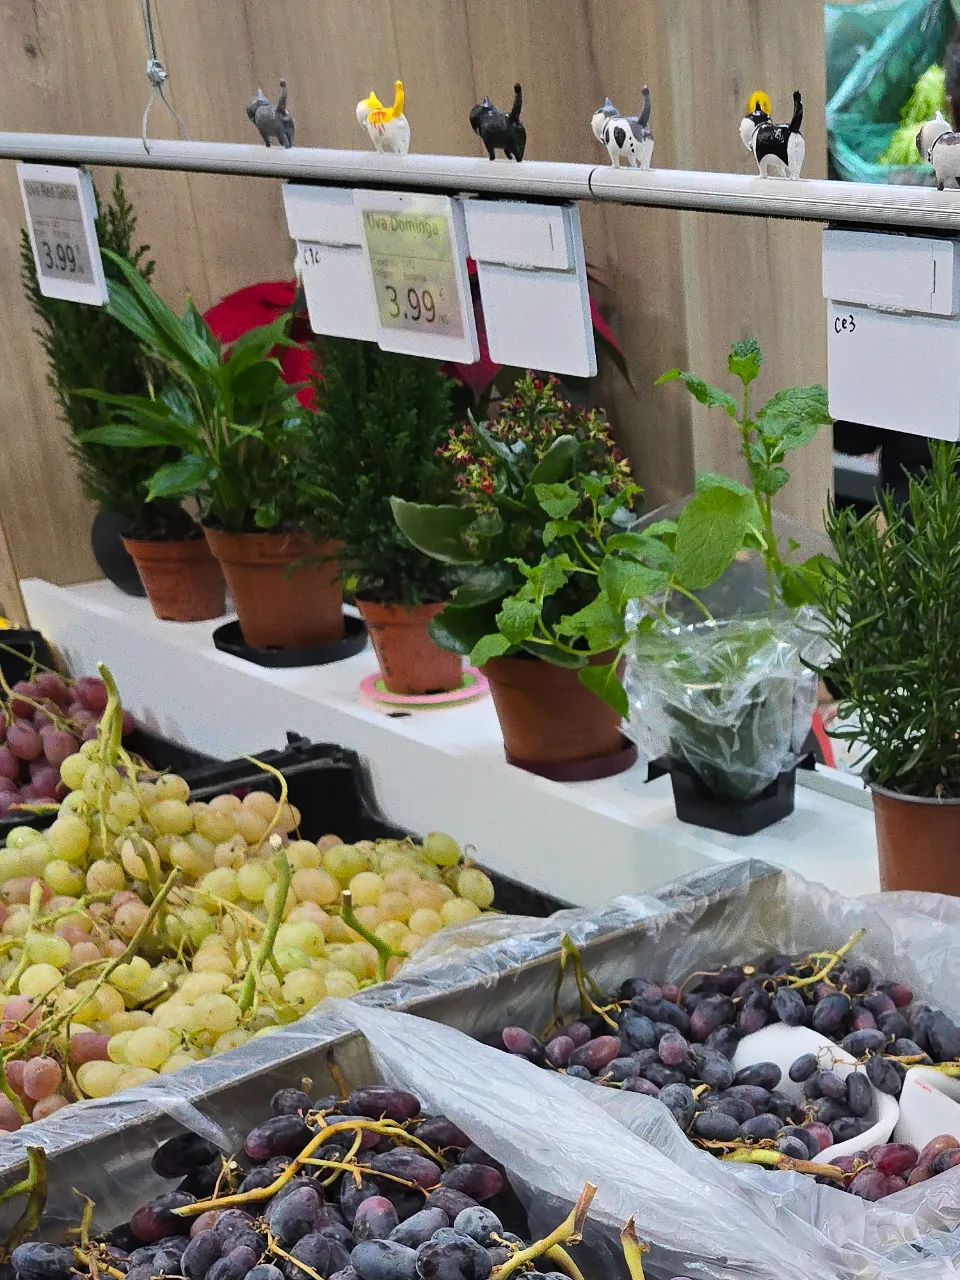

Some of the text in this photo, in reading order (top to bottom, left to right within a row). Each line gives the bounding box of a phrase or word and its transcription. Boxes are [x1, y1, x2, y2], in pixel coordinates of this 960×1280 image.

[366, 213, 439, 239] Uva Dominga
[42, 241, 77, 272] 3.99
[385, 285, 436, 323] 3.99
